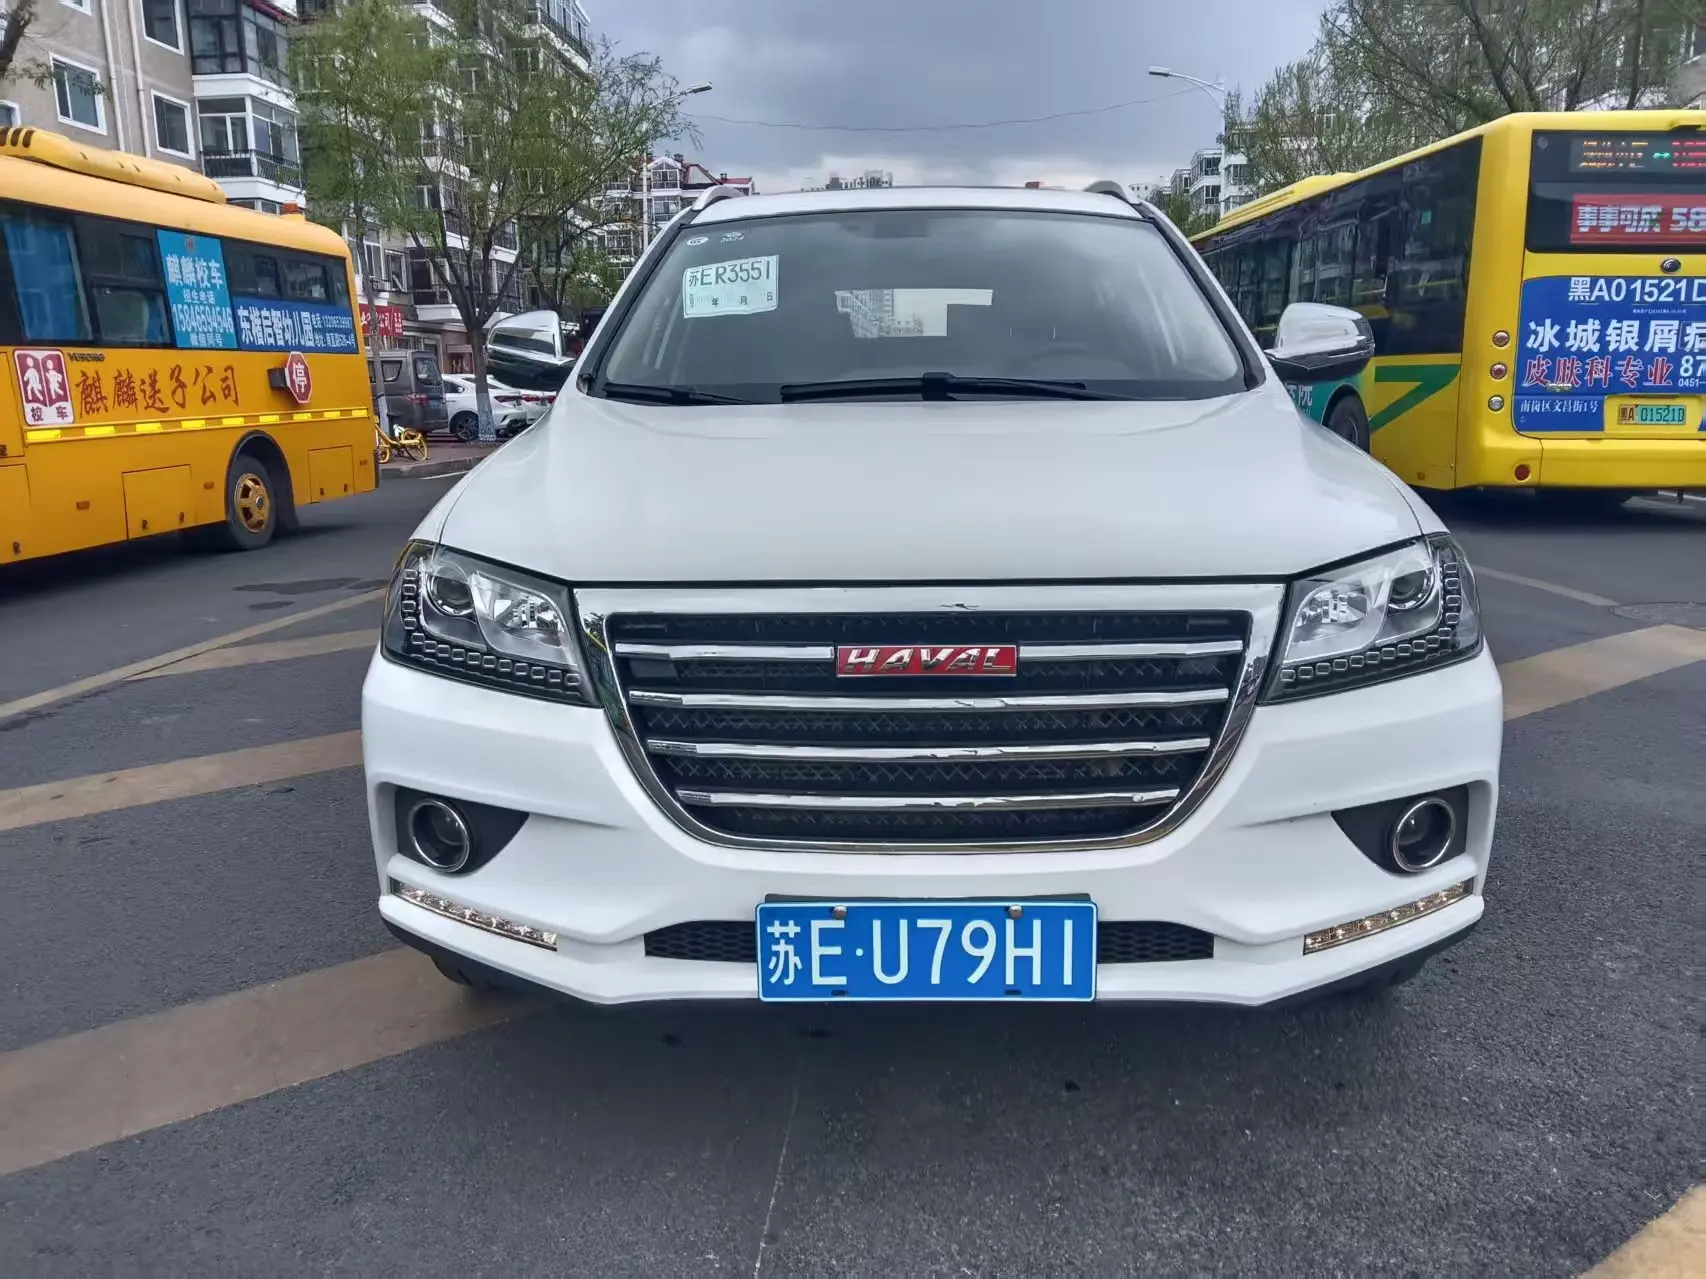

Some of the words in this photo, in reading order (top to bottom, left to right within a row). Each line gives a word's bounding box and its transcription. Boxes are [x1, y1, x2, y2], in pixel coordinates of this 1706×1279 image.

[166, 253, 223, 290] 麒麟校车
[688, 260, 770, 287] 苏ER3551
[293, 362, 307, 393] 停
[1521, 354, 1673, 388] 皮肤科专业
[30, 405, 68, 421] 校车
[1520, 400, 1599, 413] 南岗区文昌街1号
[844, 648, 1012, 672] HAVAL
